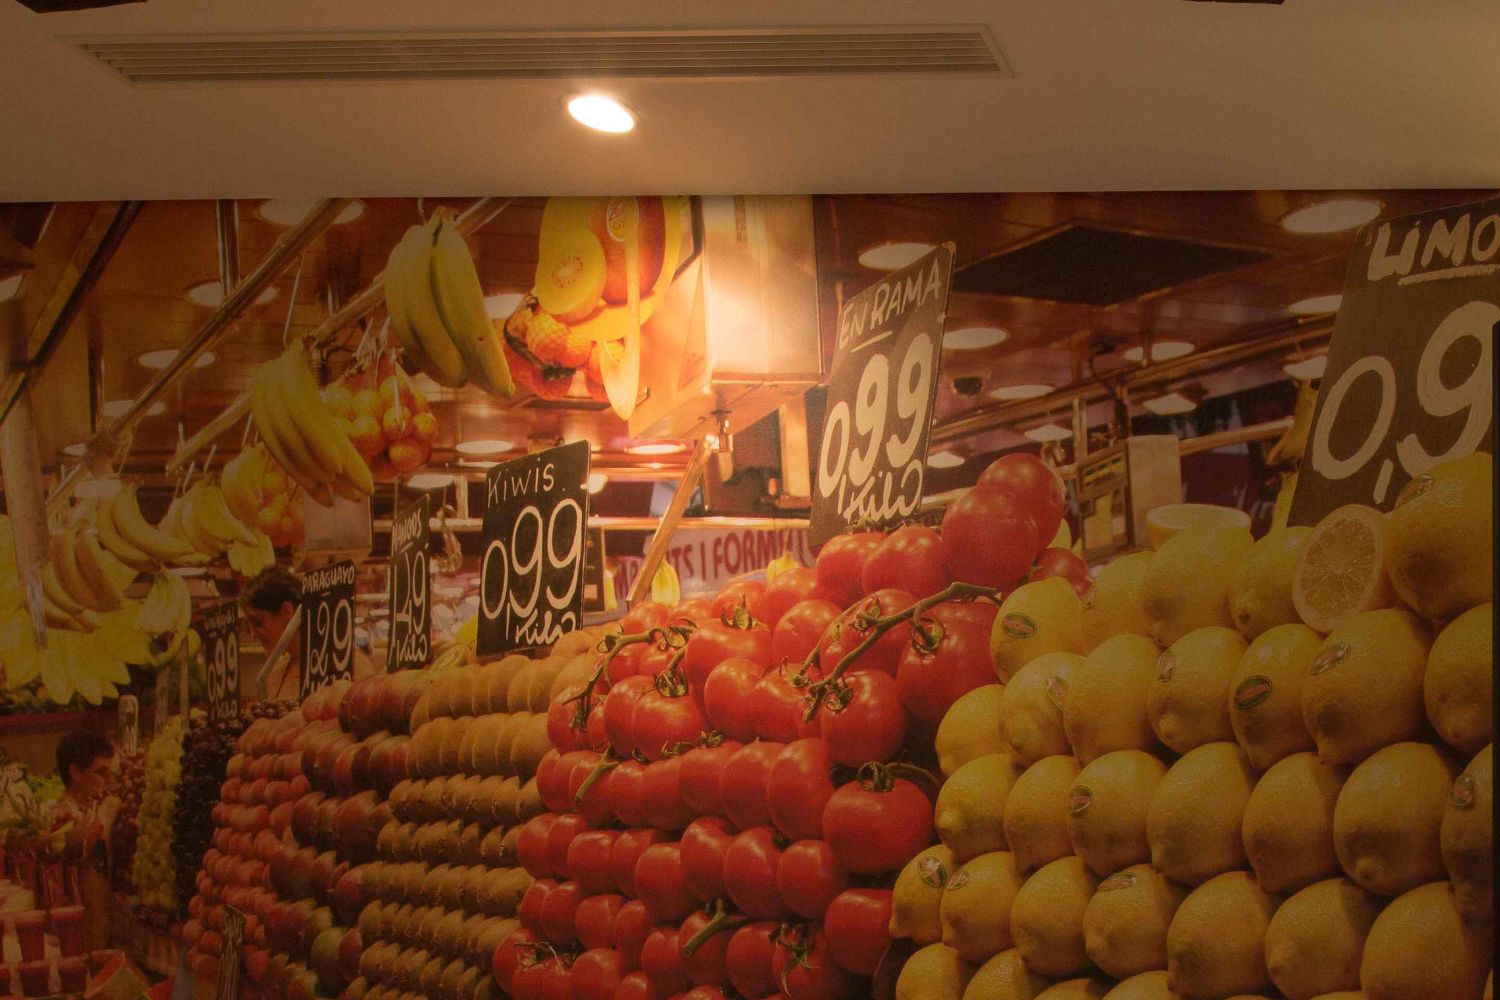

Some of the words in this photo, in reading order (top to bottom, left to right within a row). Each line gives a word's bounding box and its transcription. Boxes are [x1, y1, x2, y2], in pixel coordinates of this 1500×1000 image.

[838, 302, 869, 350] EN
[871, 257, 942, 331] RAMA
[302, 565, 355, 594] PARAGUAYO
